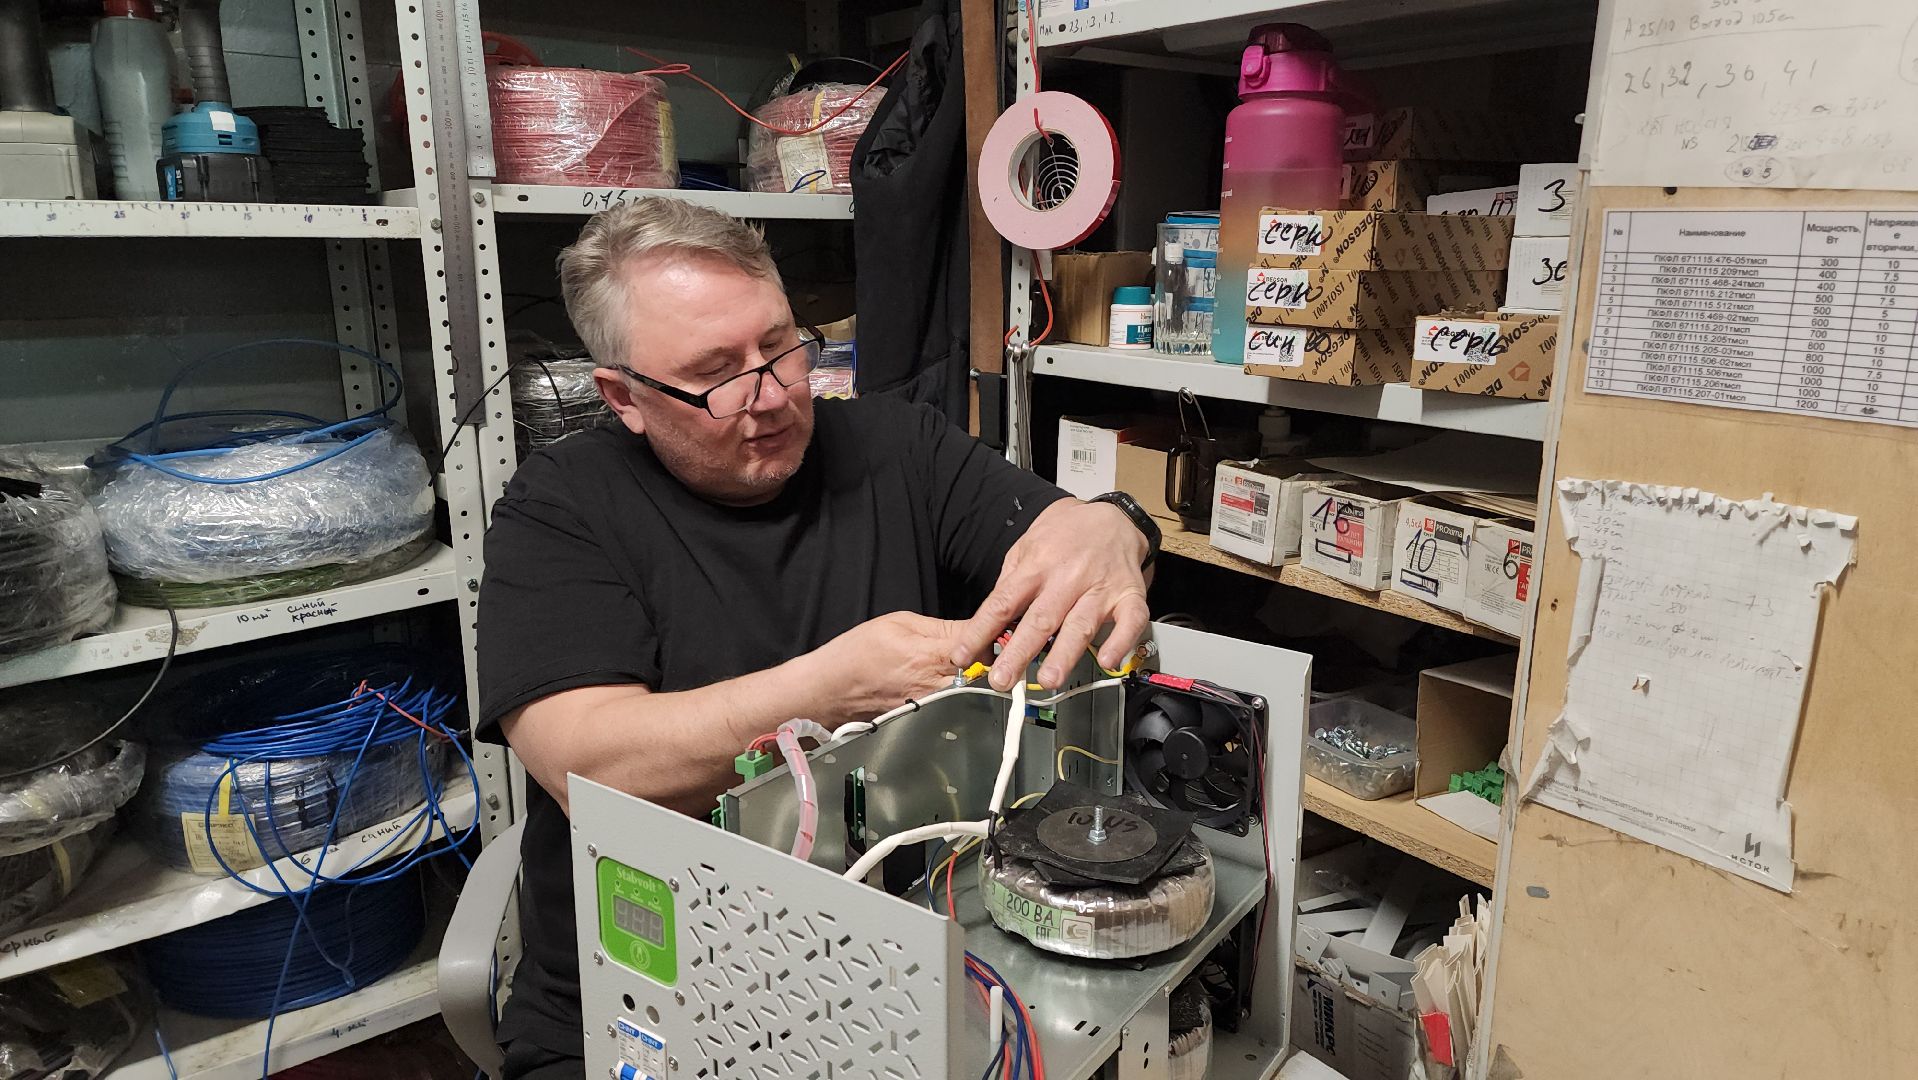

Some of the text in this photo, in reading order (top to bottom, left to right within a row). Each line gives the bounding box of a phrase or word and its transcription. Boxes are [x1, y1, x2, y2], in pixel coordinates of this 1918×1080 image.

[114, 210, 126, 219] 25
[243, 212, 252, 221] 15
[1679, 229, 1746, 238] Наименование
[1826, 236, 1839, 244] Вт
[1654, 254, 1679, 263] ПКФЛ
[1821, 259, 1839, 267] 300
[1888, 260, 1900, 269] 10
[1660, 266, 1685, 274] ПКФЛ
[1819, 271, 1837, 279] 400
[1652, 276, 1677, 285] ПКФЛ
[1817, 283, 1836, 291] 400
[1884, 285, 1896, 294] 10
[1657, 288, 1682, 297] ПКФЛ
[1815, 295, 1834, 303] 500
[1655, 299, 1680, 307] ПКФЛ
[1813, 306, 1831, 315] 500
[1882, 310, 1888, 318] 5
[1648, 309, 1673, 318] ПКФЛ
[1811, 318, 1829, 327] 600
[1878, 322, 1889, 331] 10
[1652, 320, 1677, 329] ПКФЛ
[1810, 330, 1828, 339] 700
[1875, 334, 1888, 343] 10
[1651, 331, 1676, 340] ПКФЛ
[1807, 342, 1826, 351] 800
[1873, 346, 1885, 355] 15
[1641, 352, 1666, 360] ПКФЛ
[1801, 365, 1825, 375] 1000
[1643, 341, 1667, 350] ПКФЛ
[1805, 353, 1824, 362] 800
[1871, 359, 1883, 367] 10
[1646, 363, 1671, 372] ПКФЛ
[1800, 376, 1822, 386] 1000
[1867, 383, 1879, 391] 10
[1636, 384, 1661, 393] ПКФЛ
[1795, 400, 1818, 409] 1200
[1644, 373, 1669, 382] ПКФЛ
[1798, 388, 1820, 398] 1000
[1865, 395, 1876, 403] 15
[1312, 497, 1353, 534] 16
[1436, 523, 1463, 538] PROxima
[1406, 528, 1437, 572] 10
[236, 614, 250, 623] 10
[1655, 815, 1697, 833] установки
